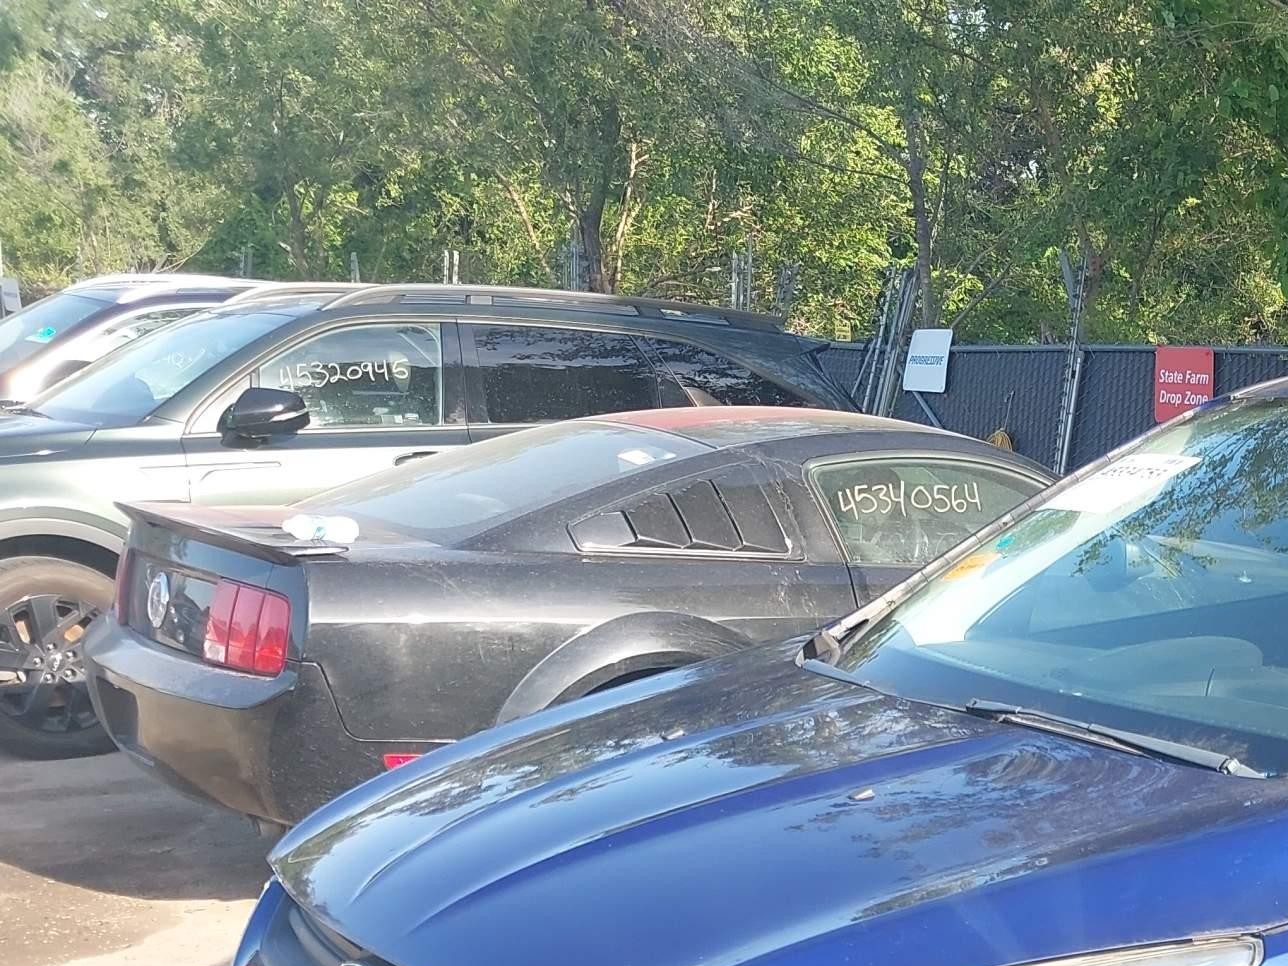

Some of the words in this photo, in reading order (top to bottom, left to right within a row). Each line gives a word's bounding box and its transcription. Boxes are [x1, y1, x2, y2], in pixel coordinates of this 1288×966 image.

[279, 359, 409, 392] 45320945
[1158, 369, 1183, 385] State
[1186, 370, 1209, 386] Farm
[1159, 390, 1182, 407] Drop
[1184, 391, 1209, 405] Zone
[837, 479, 982, 521] 45340564
